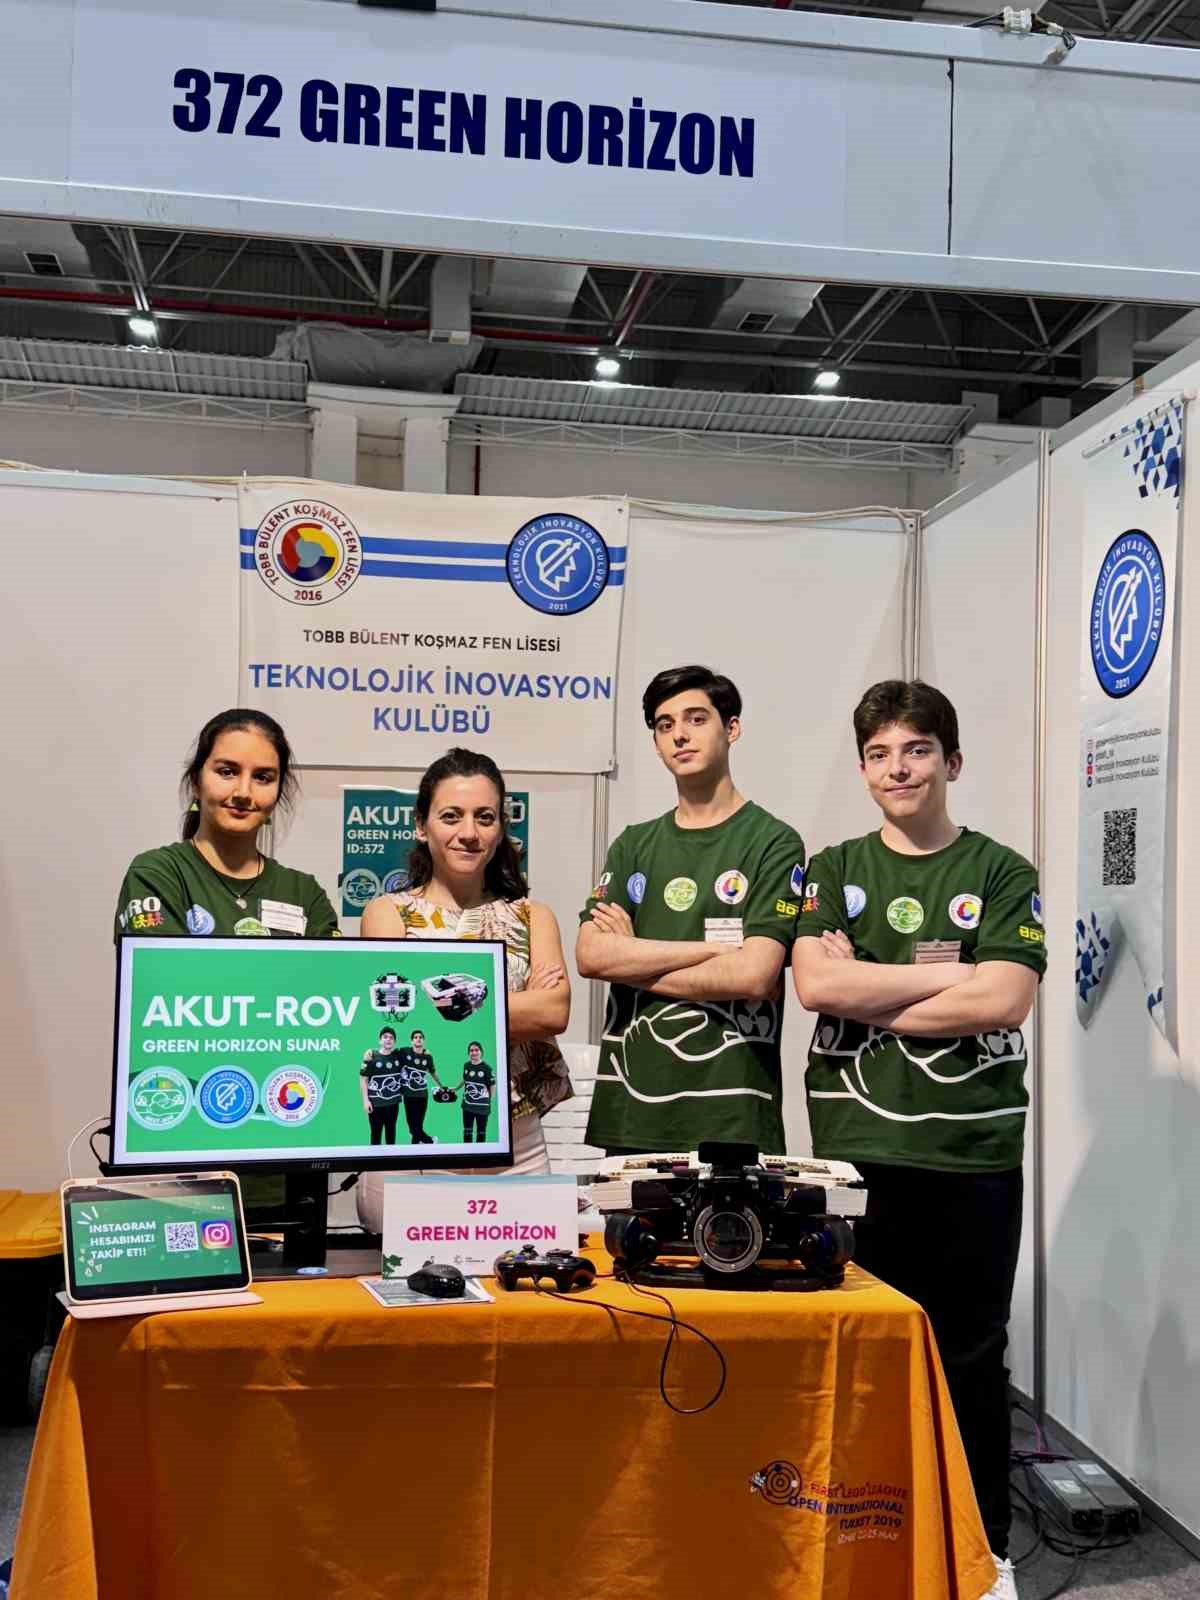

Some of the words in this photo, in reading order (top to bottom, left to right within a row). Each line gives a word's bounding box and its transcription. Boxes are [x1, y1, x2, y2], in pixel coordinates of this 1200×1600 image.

[172, 67, 283, 138] 372
[299, 78, 487, 156] GREEN
[503, 96, 755, 178] HORİZON
[293, 504, 346, 529] KOŞMAZ
[258, 508, 290, 549] BÜLENT
[342, 530, 357, 553] FEN
[258, 553, 280, 585] TOBB
[335, 555, 359, 590] LİSESİ
[294, 590, 322, 600] 2016
[303, 629, 345, 644] TOBB
[350, 628, 410, 646] BÜLENT
[414, 634, 478, 650] KOŞMAZ
[482, 636, 512, 651] FEN
[516, 635, 561, 652] LİSESİ
[248, 663, 435, 695] TEKNOLOJİK
[445, 665, 612, 700] İNOVASYON
[373, 703, 491, 734] KULÜBÜ
[347, 829, 389, 841] GREEN
[347, 843, 385, 855] ID:372
[142, 995, 361, 1027] AKUT-ROV
[142, 1039, 199, 1053] GREEN
[204, 1039, 282, 1053] HORIZON
[286, 1038, 341, 1052] SUNAR
[467, 1200, 497, 1214] 372
[89, 1221, 156, 1233] INSTAGRAM
[406, 1226, 469, 1241] GREEN
[475, 1220, 556, 1240] HORİZON
[89, 1234, 155, 1246] HESABIMIZI
[91, 1248, 126, 1260] TAKİP
